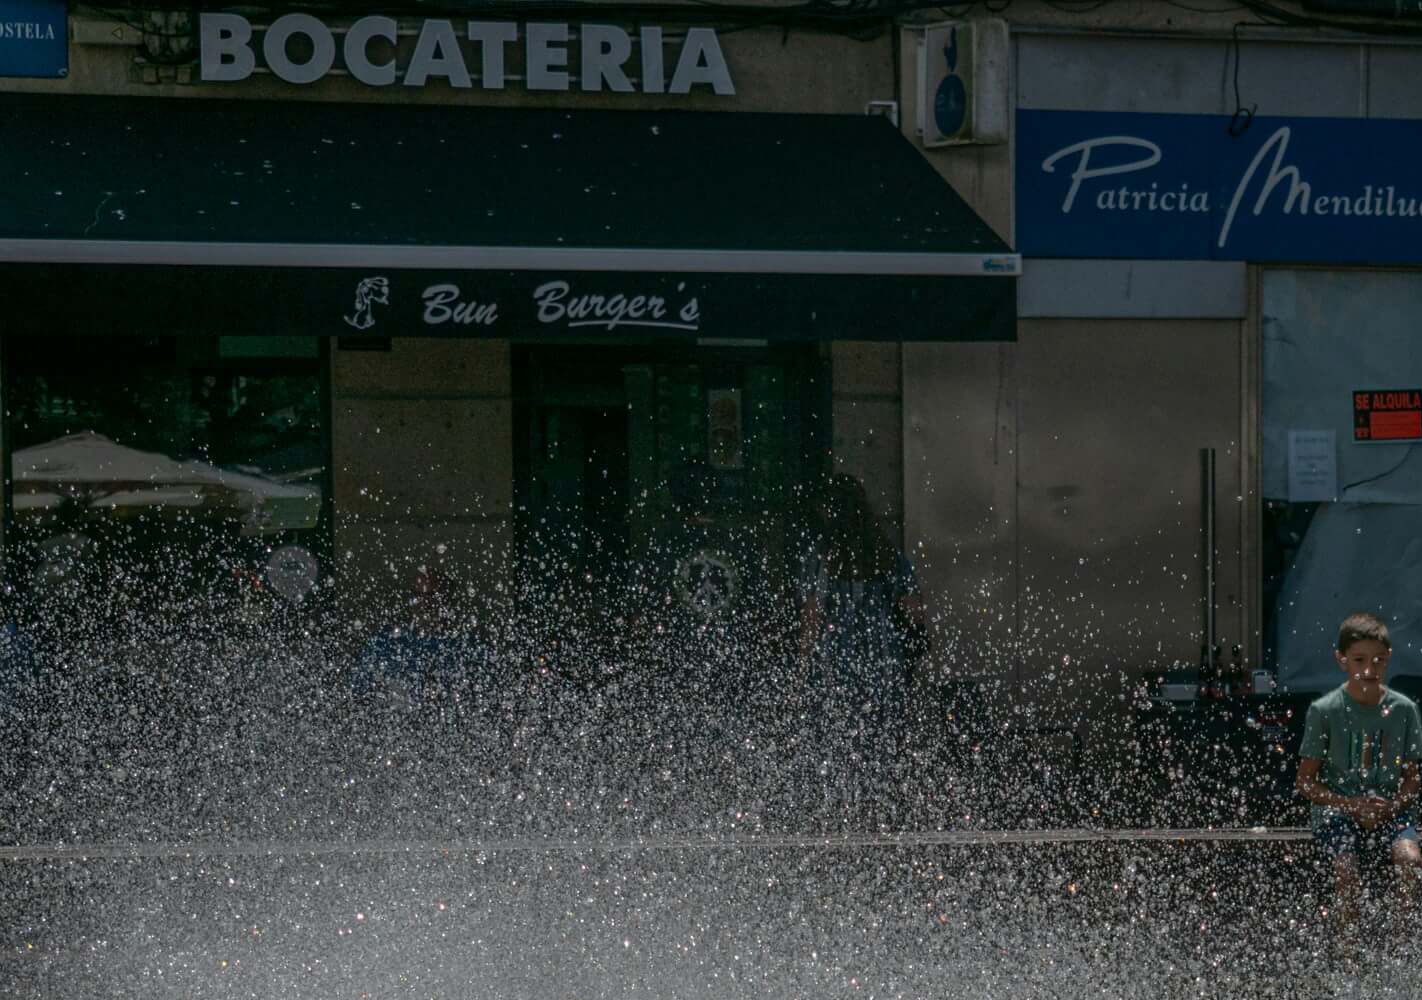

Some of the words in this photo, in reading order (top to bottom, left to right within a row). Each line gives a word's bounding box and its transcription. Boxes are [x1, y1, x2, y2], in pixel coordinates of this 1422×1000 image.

[199, 13, 737, 96] BOCATERIA
[1041, 136, 1210, 214] Patricia
[421, 284, 499, 326] Bun
[532, 280, 701, 331] Burger's
[1355, 393, 1369, 410] SE
[1373, 391, 1422, 409] ALQUILA
